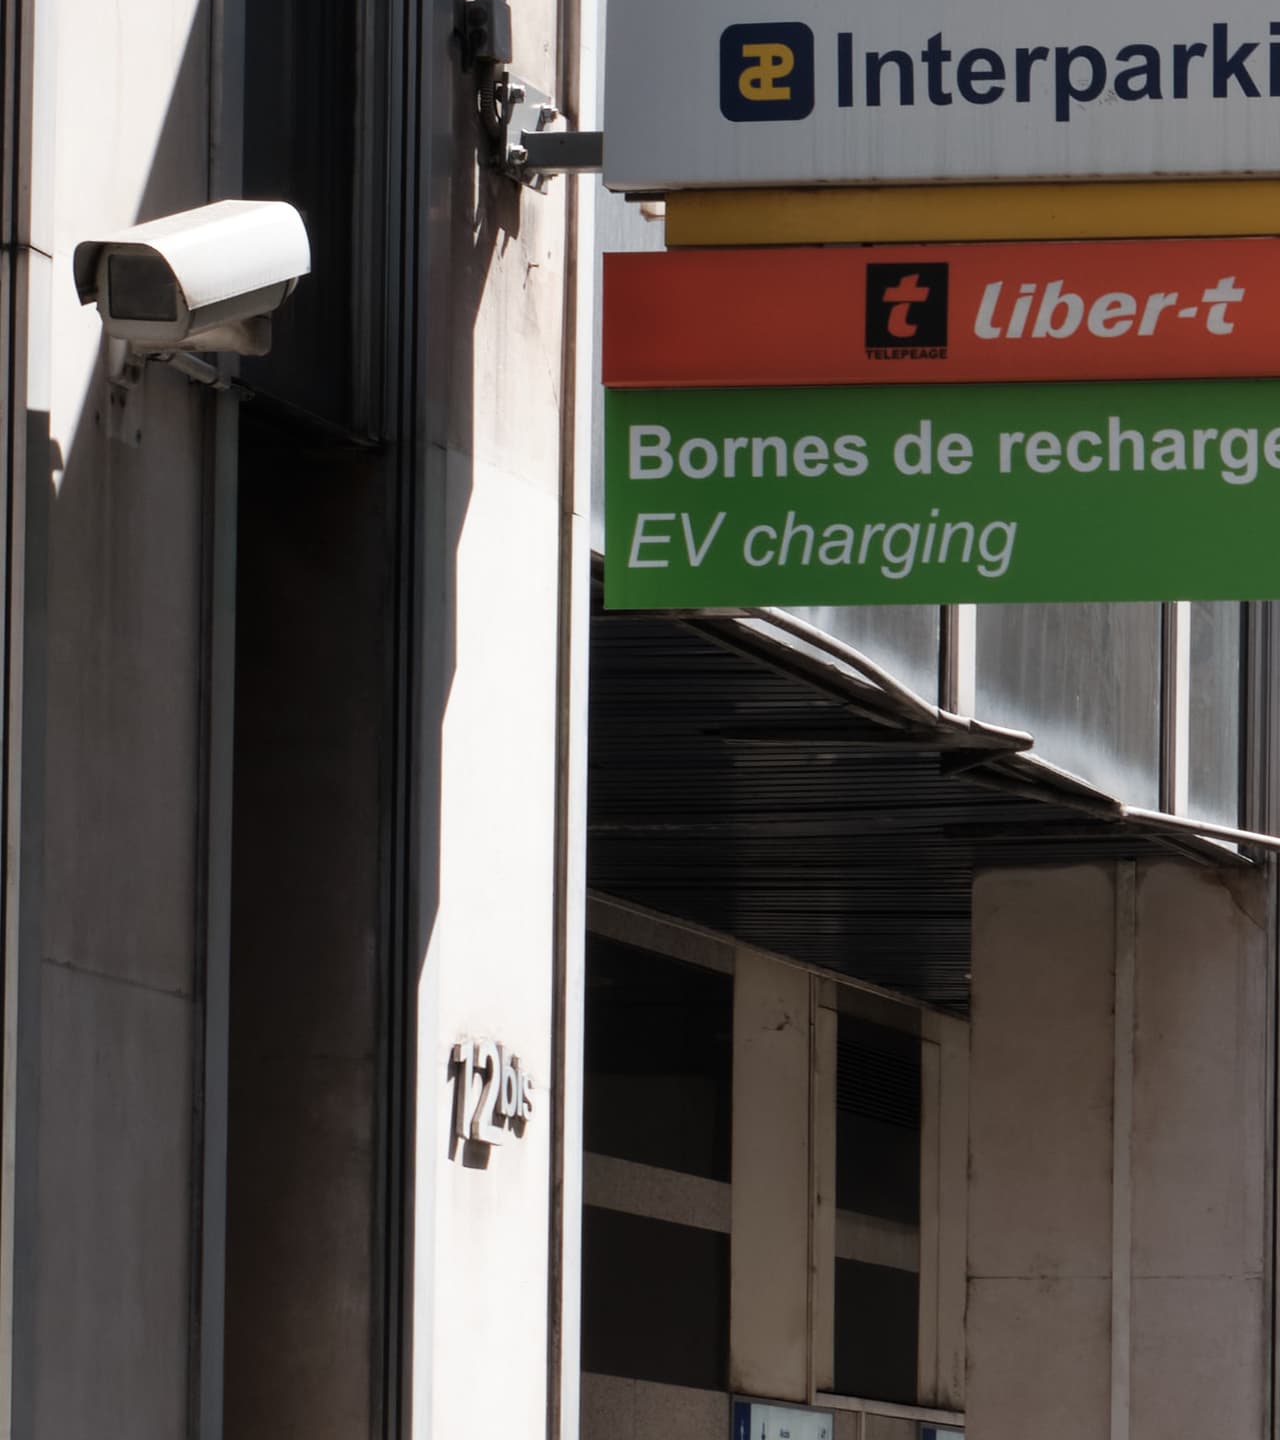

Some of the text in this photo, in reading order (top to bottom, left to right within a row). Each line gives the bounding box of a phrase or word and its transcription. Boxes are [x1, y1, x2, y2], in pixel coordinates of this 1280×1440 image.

[973, 276, 1246, 340] liber-t
[628, 423, 870, 480] Bornes
[893, 419, 974, 476] de
[627, 508, 1017, 580] EV charging
